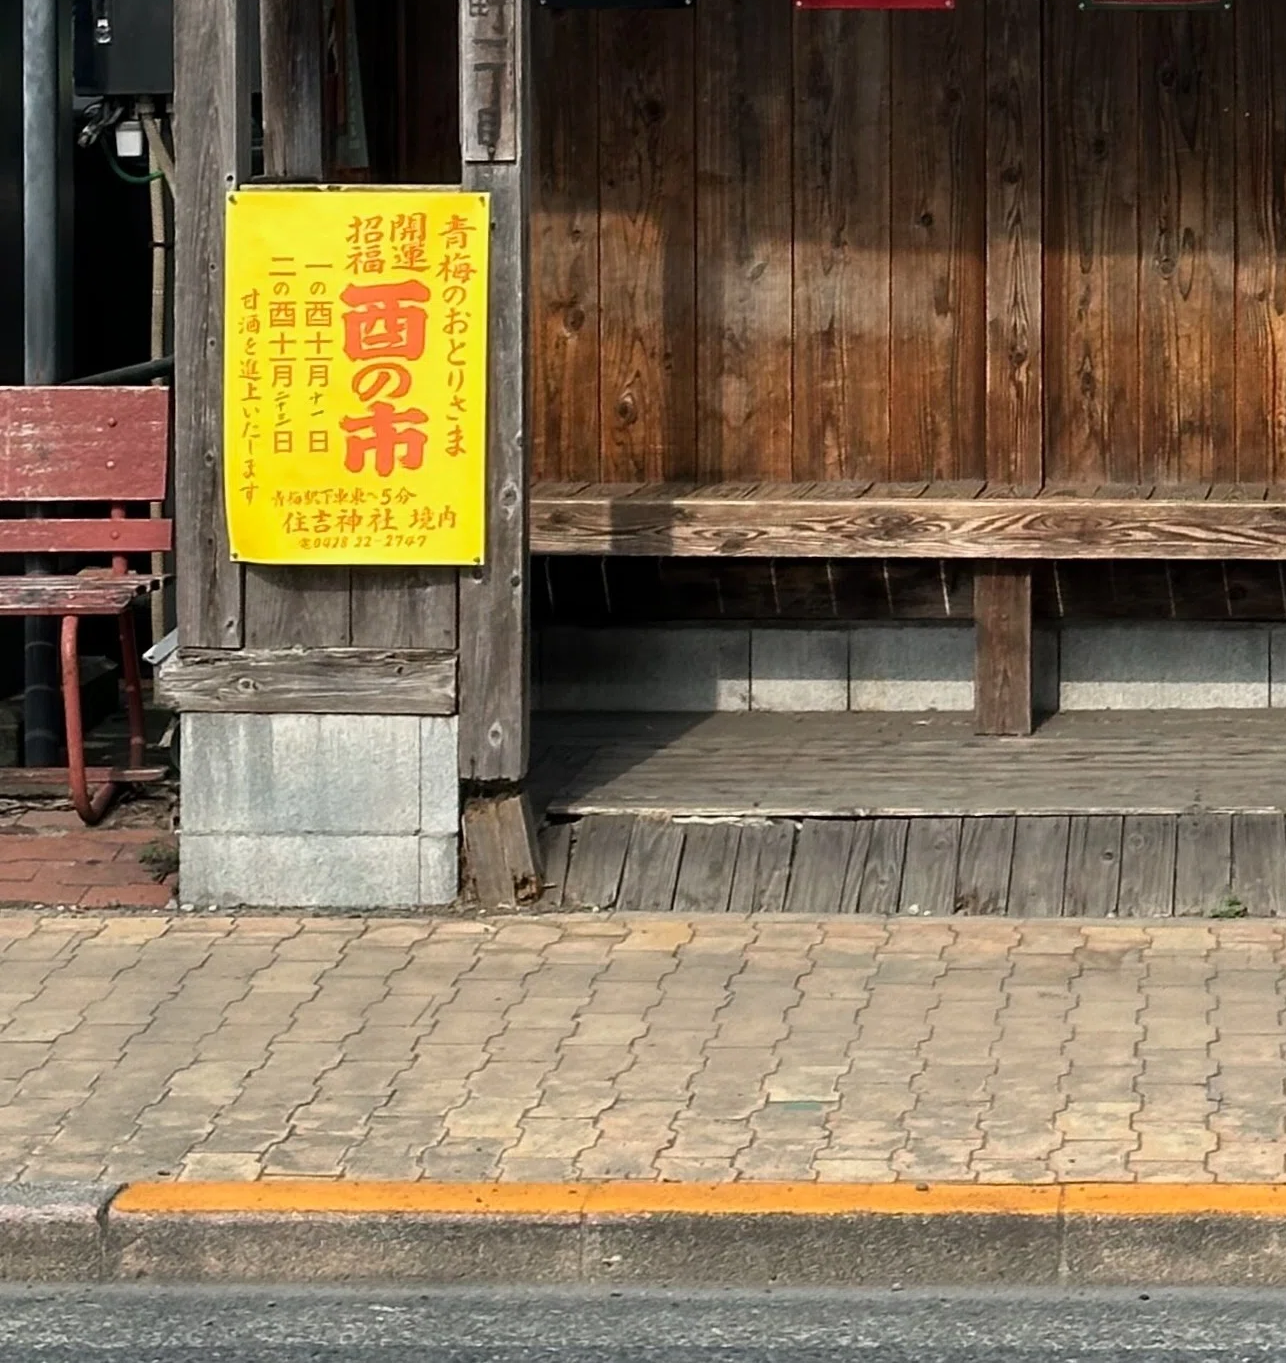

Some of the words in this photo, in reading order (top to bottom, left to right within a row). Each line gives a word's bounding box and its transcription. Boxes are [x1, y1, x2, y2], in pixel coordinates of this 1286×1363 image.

[343, 213, 386, 276] 招福
[389, 211, 432, 274] 開運
[237, 287, 263, 506] 甘酒を進上いたします
[338, 278, 432, 479] 酉の市
[436, 213, 478, 458] 青梅のおとりさま
[282, 507, 399, 534] 住吉神社
[408, 504, 458, 530] 境内
